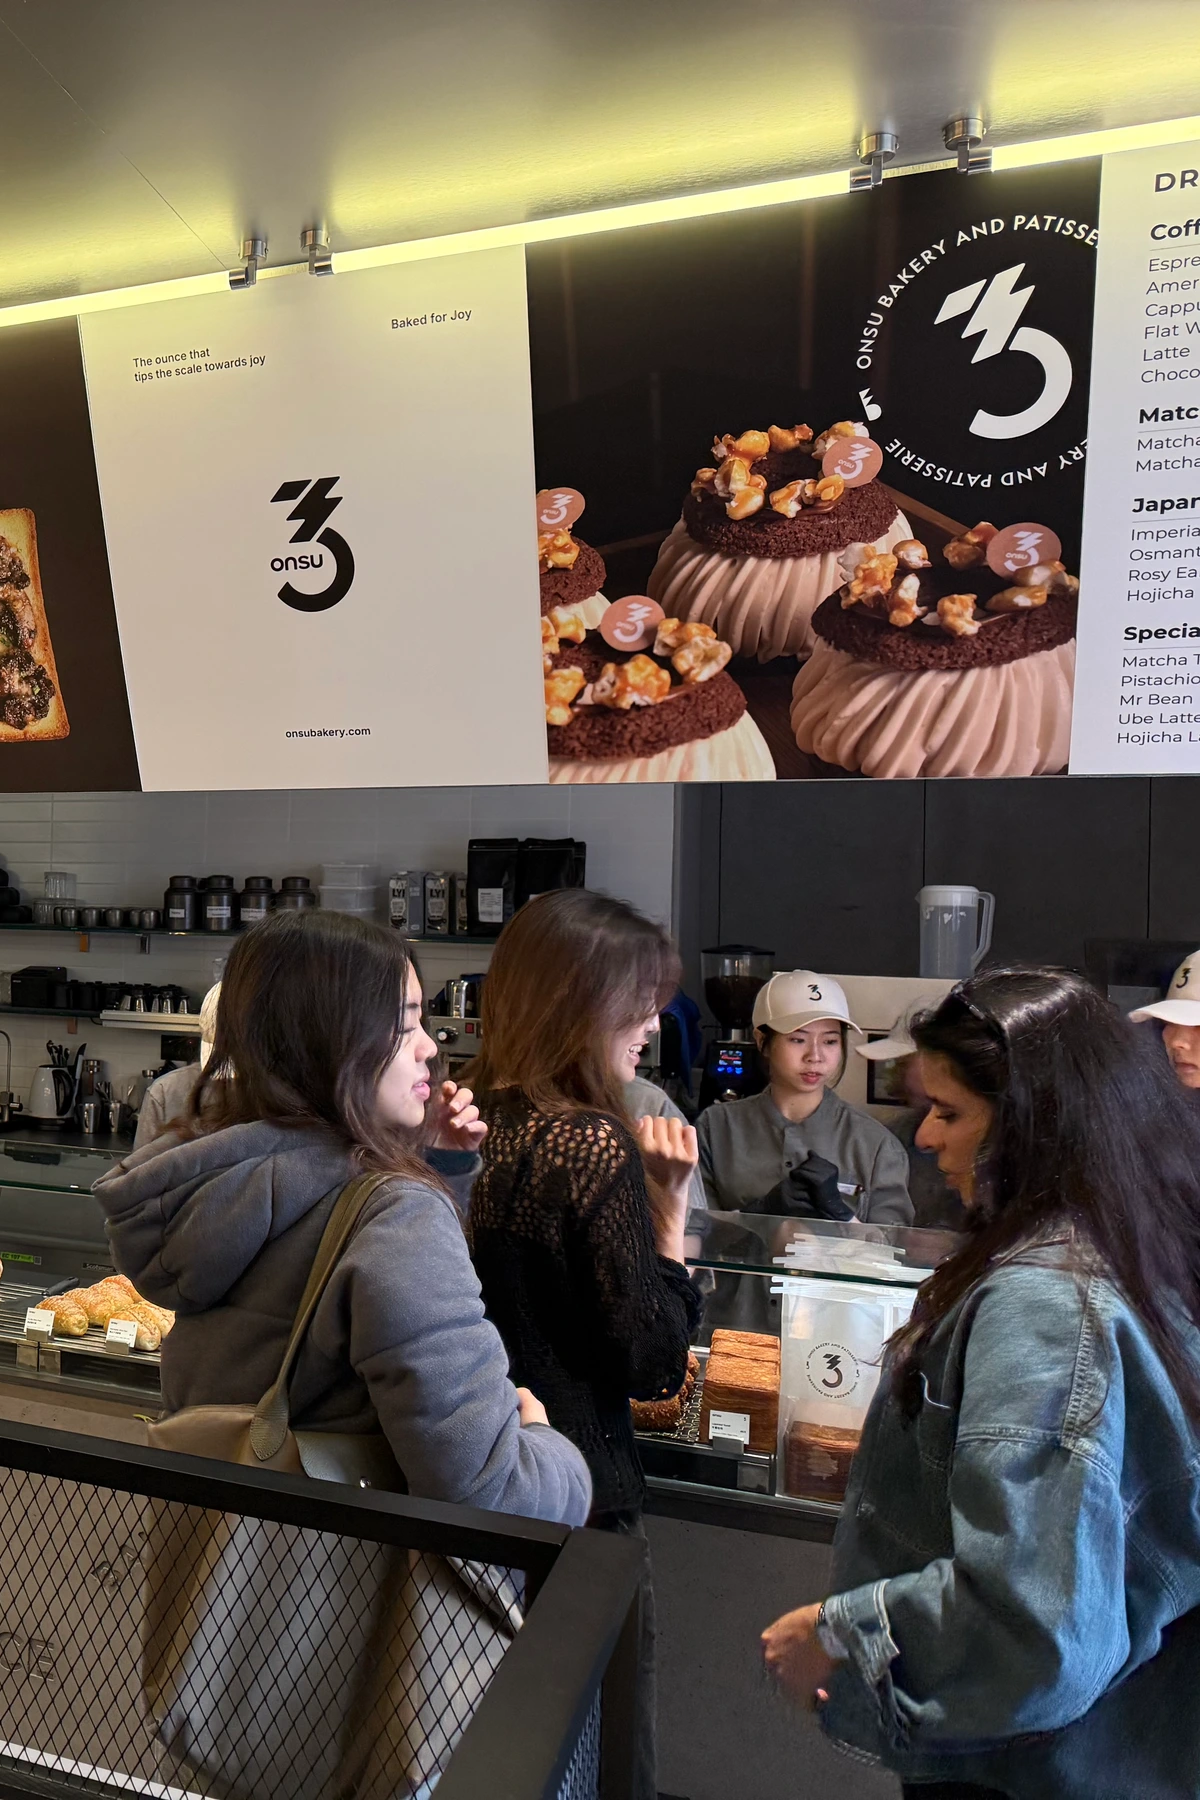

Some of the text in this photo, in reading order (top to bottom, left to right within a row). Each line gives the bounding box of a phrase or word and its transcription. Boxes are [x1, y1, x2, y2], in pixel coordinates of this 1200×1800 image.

[1155, 169, 1199, 192] DR
[1150, 218, 1200, 240] Coff
[1149, 256, 1200, 272] Espre
[856, 214, 1100, 369] ONSU BAKERY AND PATISSE
[1146, 279, 1200, 295] Amer
[391, 309, 472, 330] Baked for Joy
[1144, 324, 1179, 340] Flat
[133, 348, 210, 369] The ounce that
[1143, 347, 1190, 362] Latte
[134, 354, 266, 384] tips the scale towards joy
[1141, 368, 1200, 383] Choco
[1139, 406, 1199, 424] Matc
[885, 438, 992, 488] PATISSERIE
[1000, 462, 1048, 486] AND
[1131, 525, 1200, 542] Imperia
[1128, 566, 1200, 582] Rosy Ea
[1128, 587, 1194, 603] Hojicha
[1124, 623, 1200, 643] Specia
[1122, 654, 1188, 668] Matcha
[1122, 674, 1200, 686] Pistachio
[1120, 694, 1192, 706] Mr Bean
[1118, 713, 1200, 724] Ube Latte
[285, 727, 371, 738] onsubakery.com
[1118, 732, 1182, 745] Hojicha
